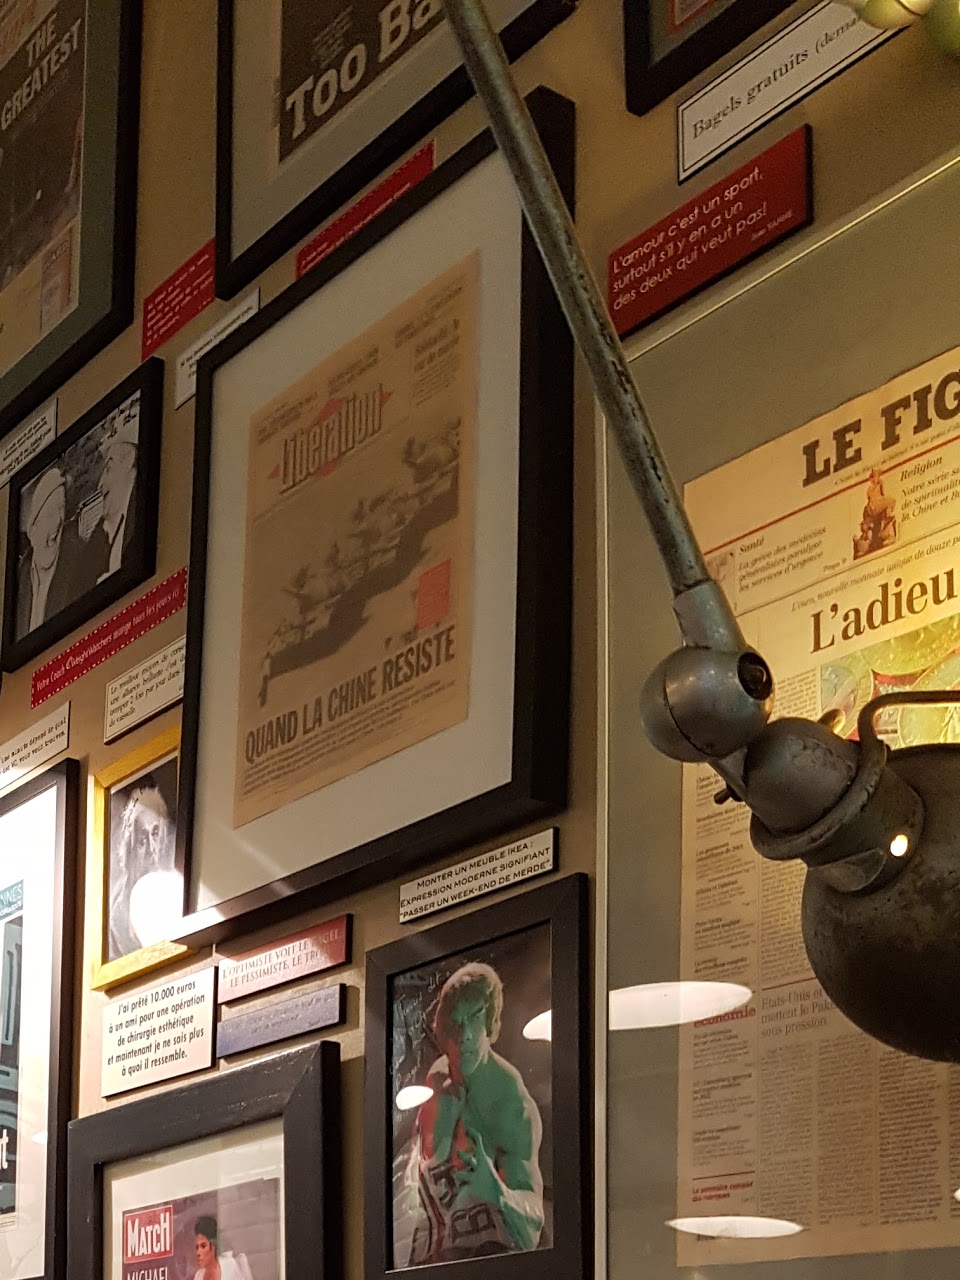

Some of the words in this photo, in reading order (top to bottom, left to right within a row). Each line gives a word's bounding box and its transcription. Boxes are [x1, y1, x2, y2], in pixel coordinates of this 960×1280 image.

[27, 12, 57, 67] THE
[1, 18, 81, 130] GREATEST
[692, 95, 742, 140] Bagels
[747, 49, 809, 105] gratuits
[814, 17, 858, 55] (dema
[612, 253, 657, 292] surtout
[689, 224, 707, 243] en
[724, 200, 744, 220] un
[613, 233, 664, 274] L'amour
[668, 208, 699, 237] c'est
[703, 197, 721, 216] un
[613, 291, 636, 311] des
[640, 268, 673, 294] deux
[676, 247, 699, 271] qui
[701, 228, 734, 254] veut
[736, 202, 768, 235] pas!
[802, 418, 862, 488] LE
[810, 567, 958, 655] L'adieu
[245, 710, 298, 765] QUAND
[302, 695, 323, 735] LA
[327, 666, 377, 723] CHINE
[382, 625, 456, 696] RESISTE
[401, 883, 452, 908] EXPRESSION
[454, 867, 498, 888] MODERNE
[499, 847, 551, 872] SIGNIFIANT
[454, 865, 467, 876] UN
[469, 853, 505, 870] MEUBLE
[507, 843, 528, 855] IKEA
[436, 896, 449, 907] UN
[450, 880, 497, 903] WEEK-END
[498, 874, 511, 884] DE
[115, 1021, 125, 1033] un
[125, 1016, 138, 1029] ami
[139, 1011, 155, 1028] pour
[156, 1008, 169, 1021] une
[171, 994, 205, 1016] opération
[118, 1002, 130, 1016] J'ai
[131, 995, 148, 1014] prêté
[150, 986, 175, 1004] 10.000
[177, 980, 196, 996] euros
[107, 1055, 114, 1066] et
[115, 1044, 152, 1063] maintenant
[162, 1039, 171, 1051] ne
[172, 1032, 187, 1047] sais
[189, 1027, 205, 1045] plus
[117, 1035, 125, 1047] de
[127, 1026, 157, 1047] chirurgie
[158, 1014, 194, 1036] esthétique
[128, 1060, 143, 1077] quoi
[150, 1047, 188, 1069] ressemble.
